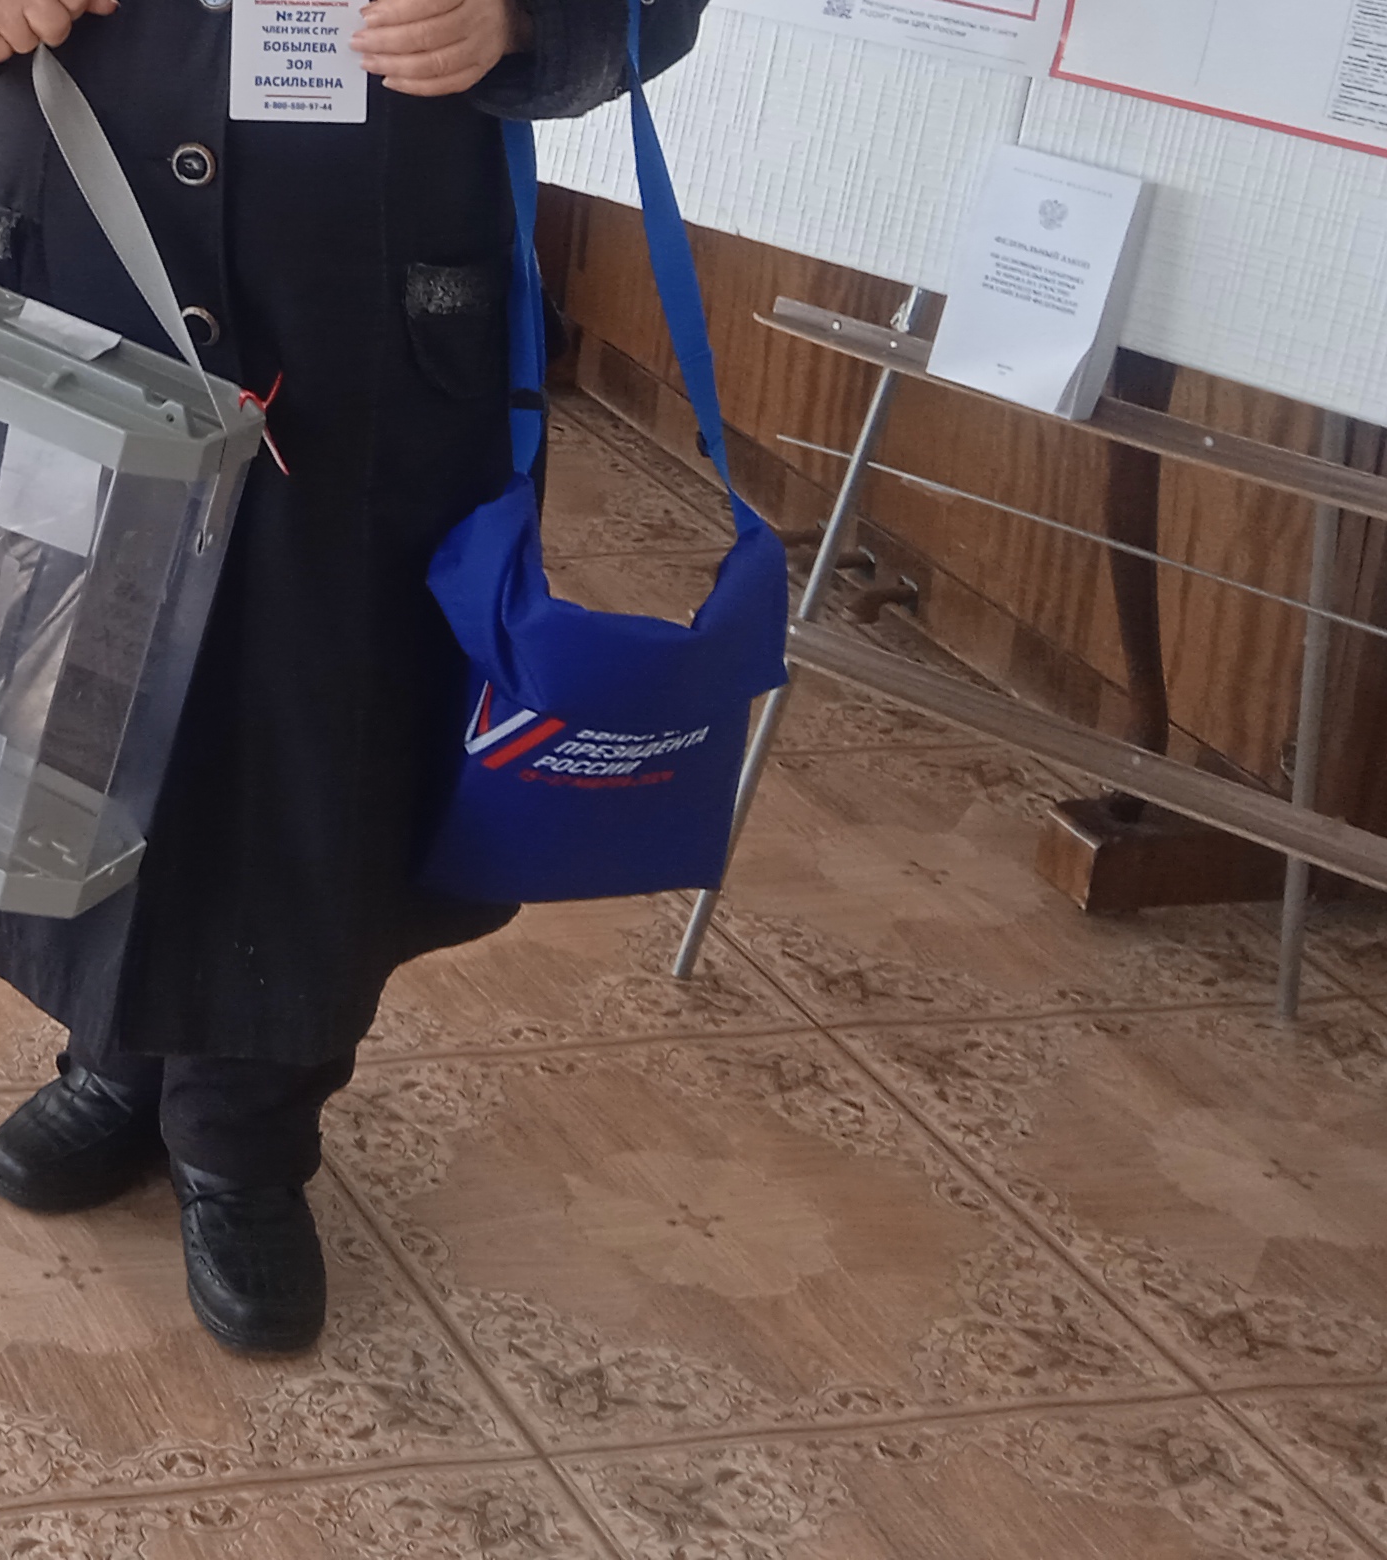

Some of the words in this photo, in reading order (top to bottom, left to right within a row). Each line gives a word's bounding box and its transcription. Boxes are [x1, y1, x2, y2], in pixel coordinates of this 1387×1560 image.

[275, 10, 293, 23] №
[295, 10, 326, 23] 2277
[261, 25, 289, 35] ЧЛЕН
[290, 25, 311, 35] УИК
[312, 26, 320, 36] С
[320, 26, 340, 36] ПРГ
[262, 40, 338, 54] БОБЫЛЕВА
[285, 58, 313, 71] ЗОЯ
[254, 75, 344, 89] ВАСИЛЬЕВНА
[553, 725, 710, 759] ПРЕЗИДЕНТА
[532, 755, 643, 776] РОССИИ
